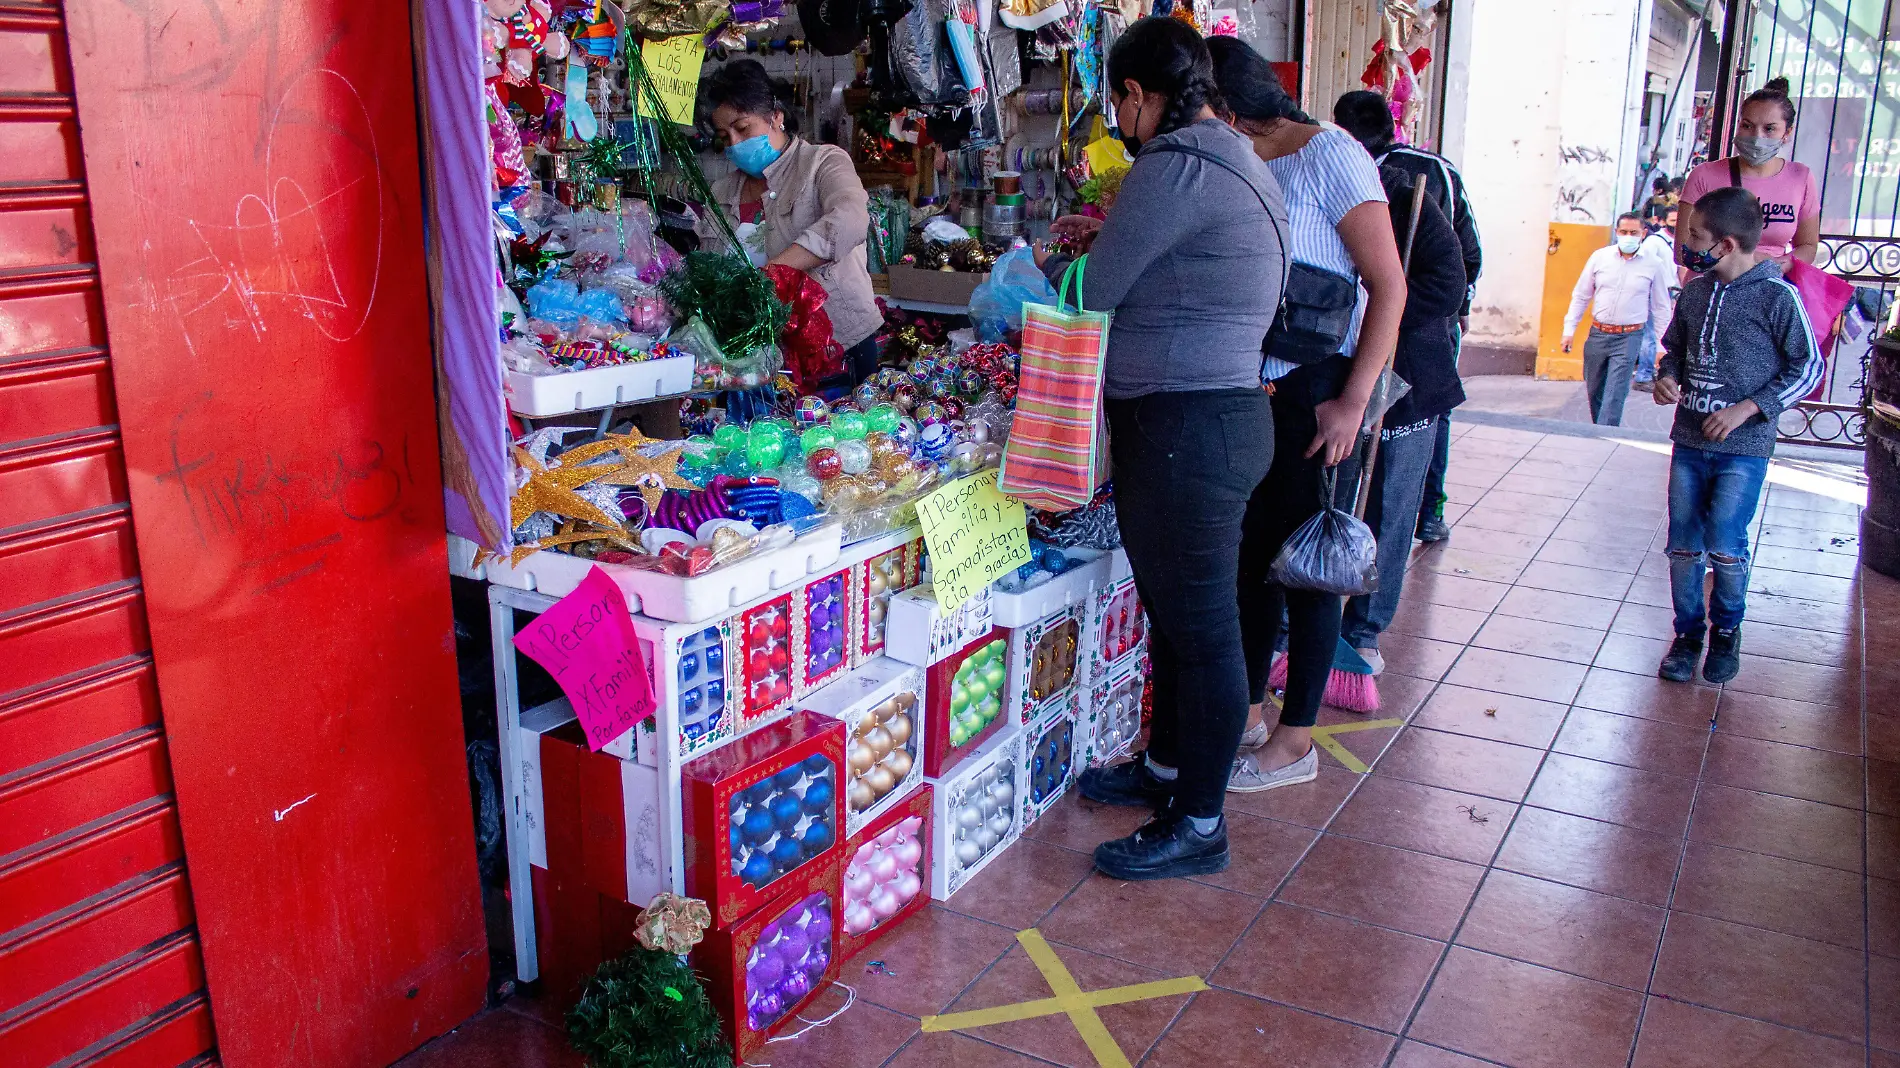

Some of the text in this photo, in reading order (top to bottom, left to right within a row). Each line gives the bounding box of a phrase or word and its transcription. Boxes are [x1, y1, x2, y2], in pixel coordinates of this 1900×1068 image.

[658, 52, 682, 75] LOS
[1757, 196, 1795, 230] gers
[1680, 391, 1737, 414] dida
[923, 474, 991, 535] 1 Persona
[932, 503, 989, 560] familia
[993, 502, 1002, 523] y
[945, 543, 1027, 610] cia gracias
